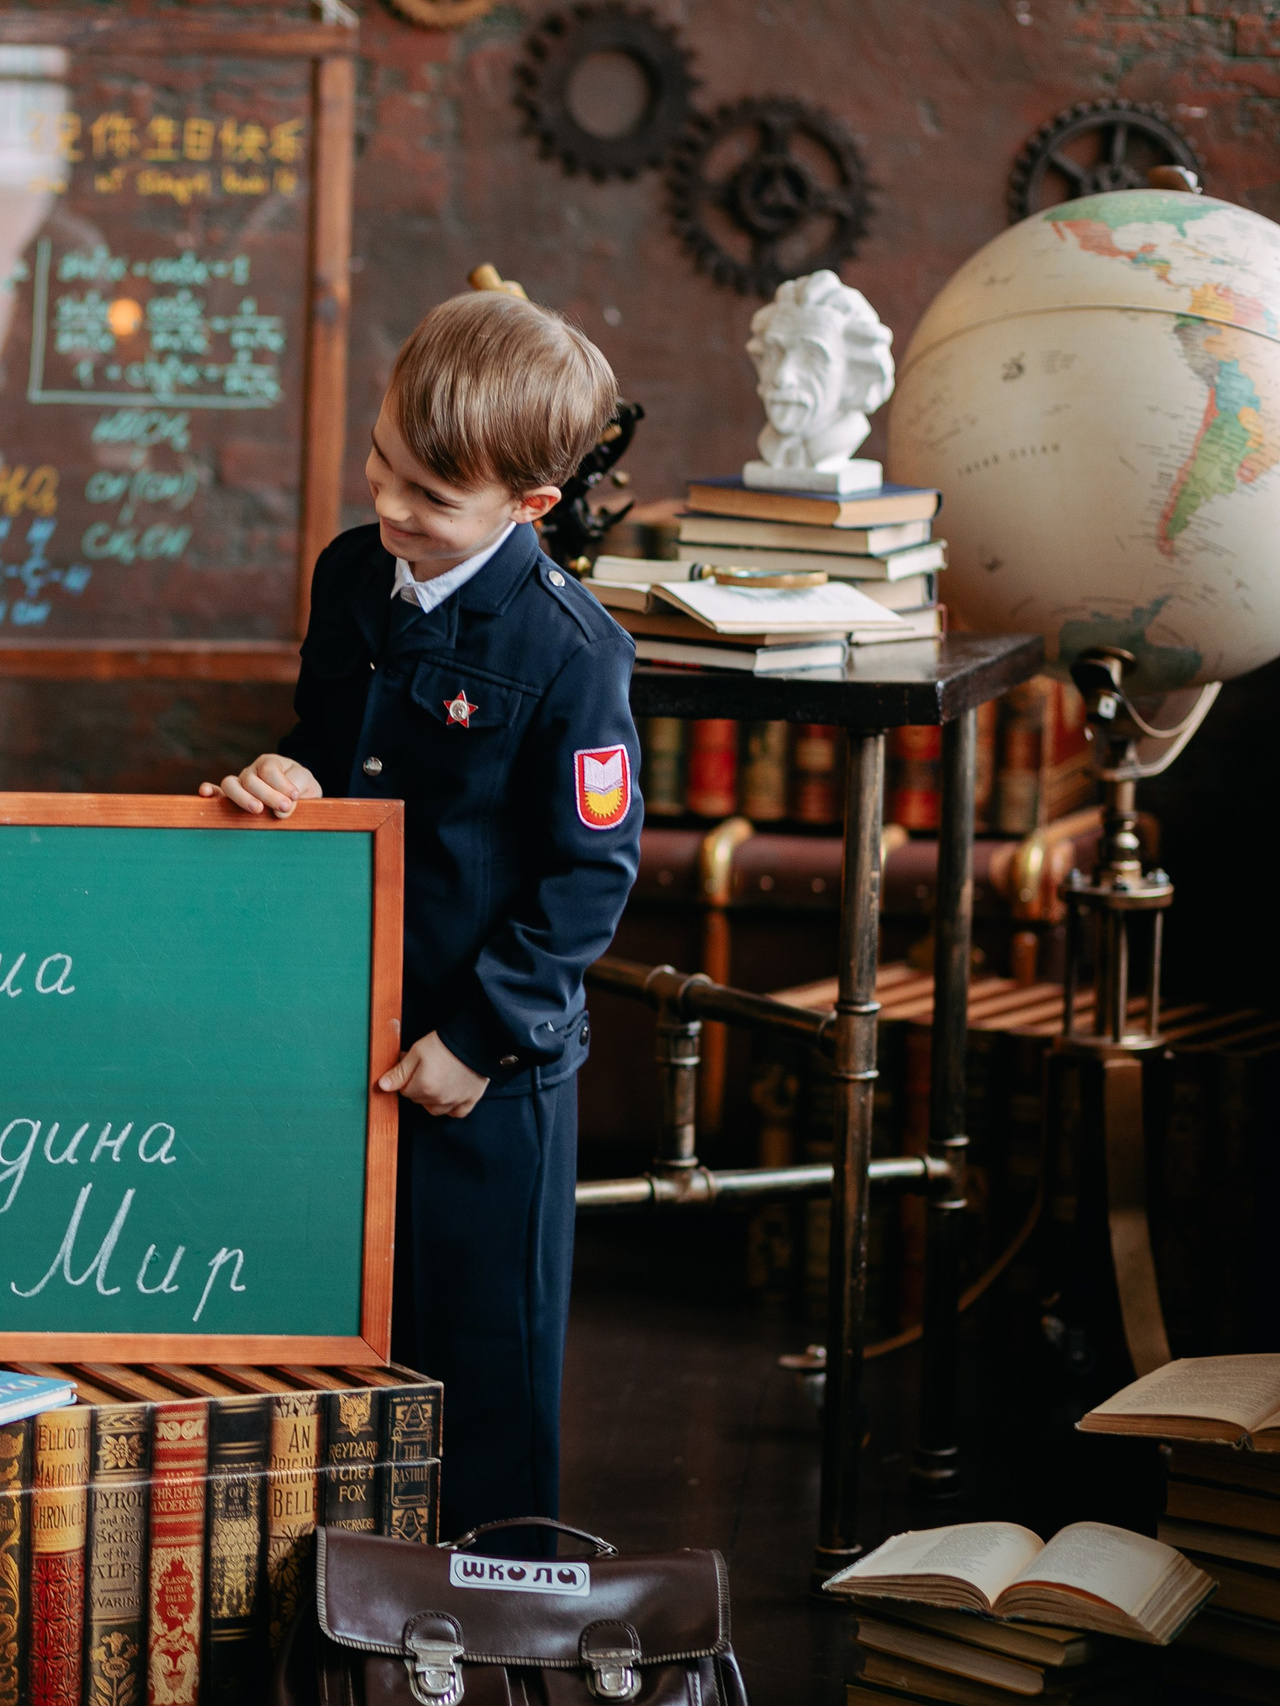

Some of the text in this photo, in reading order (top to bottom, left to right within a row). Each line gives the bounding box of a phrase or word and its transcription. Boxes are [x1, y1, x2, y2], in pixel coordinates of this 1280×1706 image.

[10, 1182, 246, 1322] Мир
[37, 1424, 90, 1452] ELLIOTT
[288, 1423, 310, 1453] AN
[404, 1444, 421, 1460] THE
[339, 1485, 366, 1502] FOX
[100, 1512, 137, 1527] and the
[103, 1546, 131, 1562] of the
